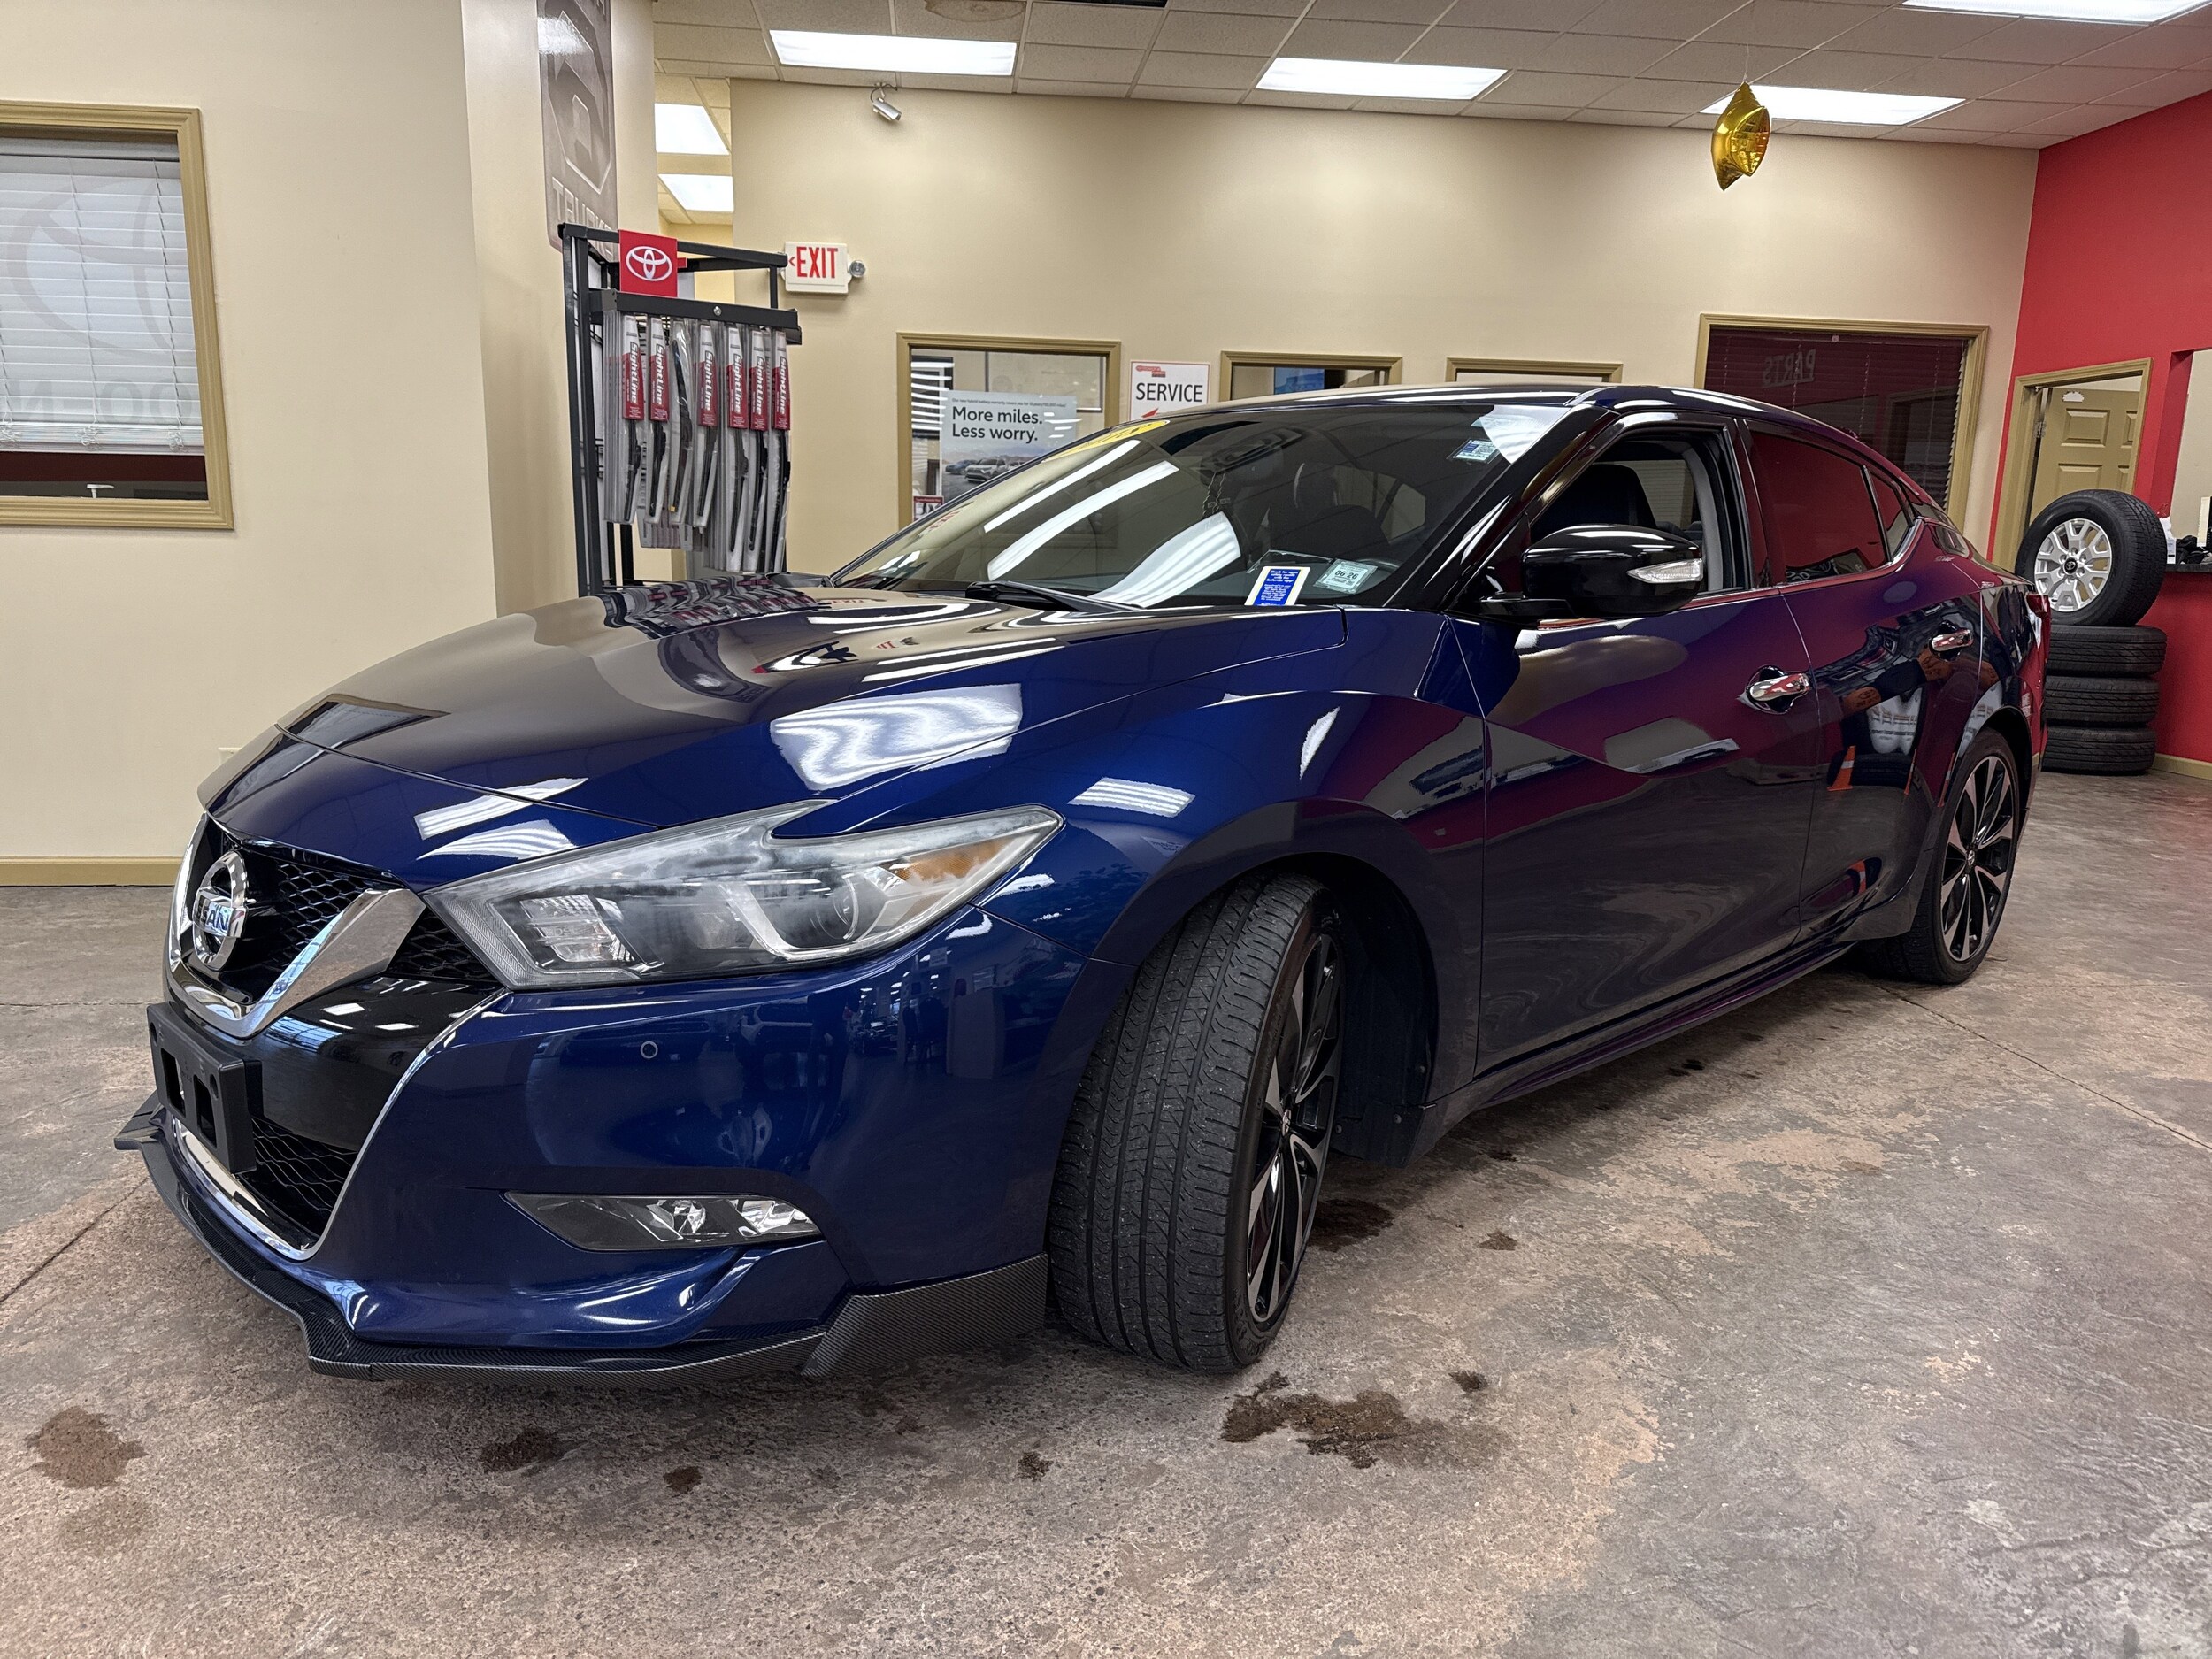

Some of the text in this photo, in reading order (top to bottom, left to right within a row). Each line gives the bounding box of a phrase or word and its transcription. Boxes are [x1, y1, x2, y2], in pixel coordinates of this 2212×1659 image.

[796, 247, 838, 279] EXIT
[1135, 382, 1203, 403] SERVICE
[952, 406, 1042, 425] More miles.
[952, 423, 1038, 443] Less worry.
